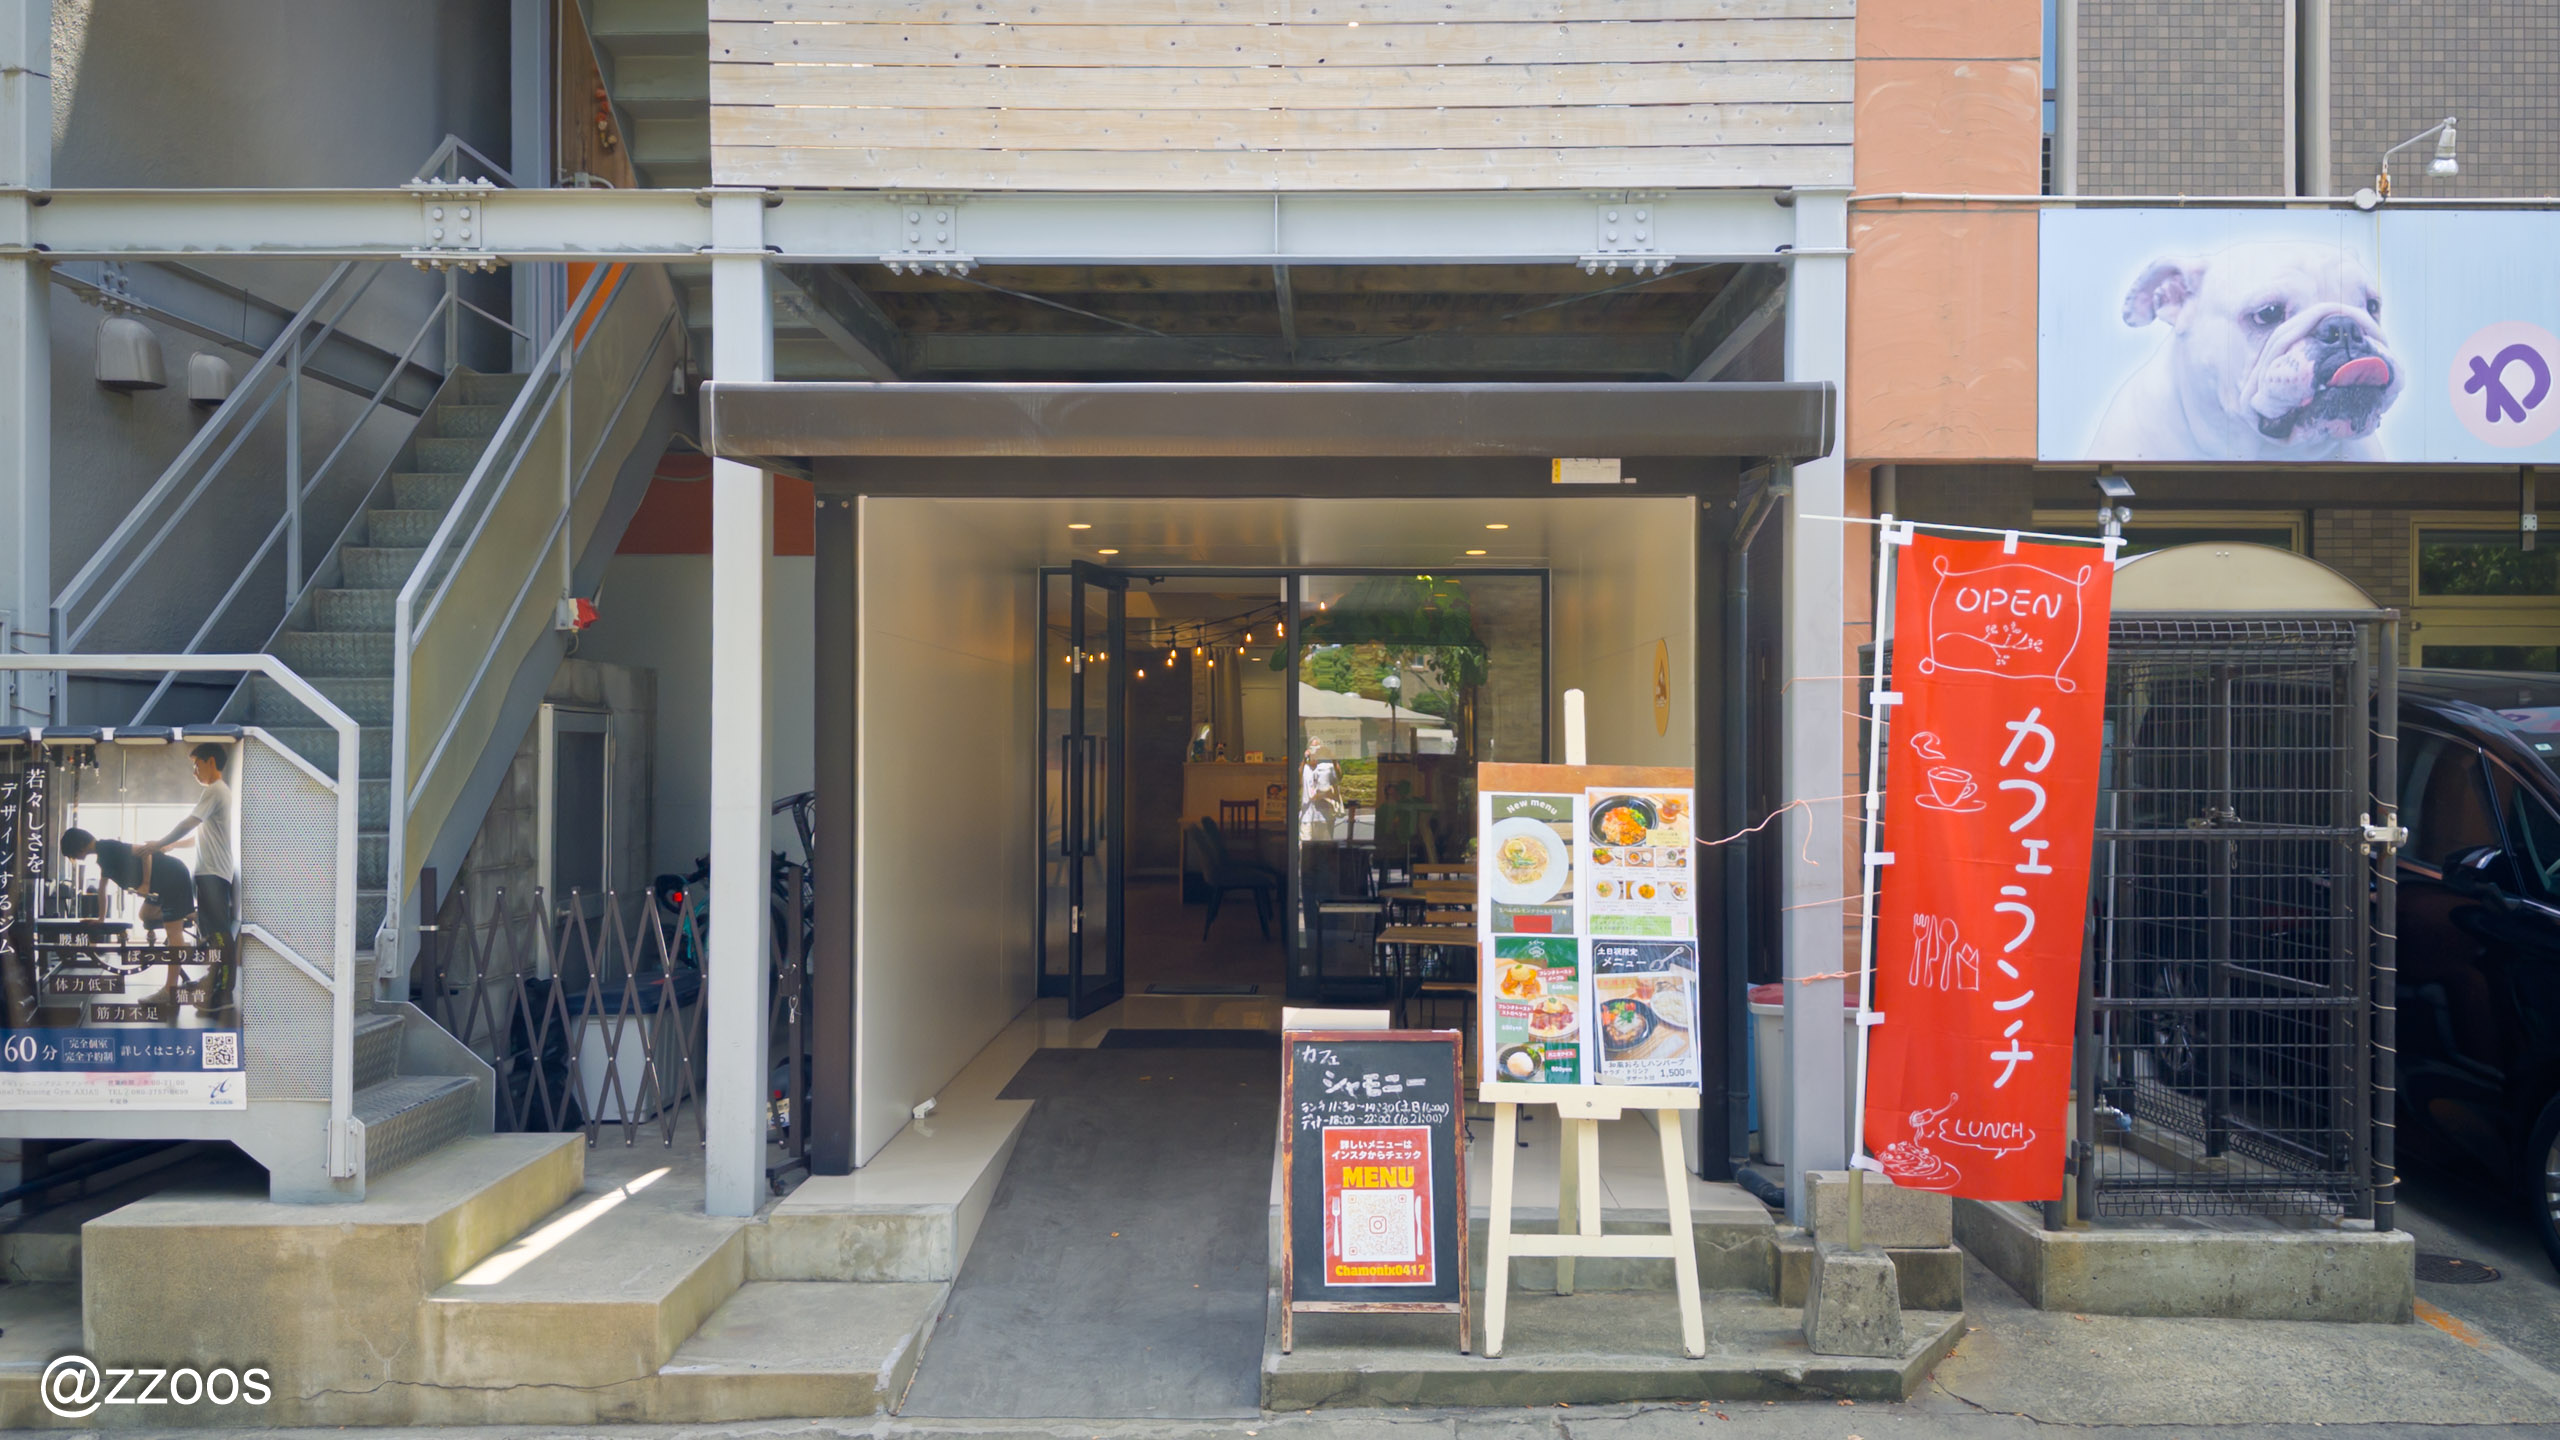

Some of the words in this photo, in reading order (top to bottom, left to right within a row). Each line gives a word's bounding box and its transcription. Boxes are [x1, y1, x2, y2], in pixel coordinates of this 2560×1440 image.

[2464, 344, 2551, 423] わ
[1956, 587, 2062, 618] OPEN
[1506, 800, 1528, 814] New
[1530, 799, 1558, 816] menu
[25, 768, 46, 874] 若々しさを
[0, 782, 18, 954] デザインするジム
[1990, 707, 2056, 1089] カフェランチ
[59, 933, 89, 946] 腰痛
[1597, 947, 1639, 957] 土日祝限定
[1602, 957, 1647, 969] メニュー
[55, 977, 119, 992] 体力低下
[176, 988, 207, 1004] 猫背
[96, 1006, 159, 1021] 筋力不足
[69, 1038, 108, 1049] 完全個室
[120, 1045, 196, 1057] 詳しくはこちら
[64, 1052, 114, 1063] 完全予約制
[1302, 1045, 1340, 1065] カフェ
[1322, 1070, 1426, 1099] シャモニー
[1301, 1100, 1325, 1113] ランチ
[1955, 1119, 2023, 1139] LUNCH
[1340, 1140, 1413, 1150] 詳しいメニューは
[1331, 1151, 1422, 1160] インスタからチェック
[1342, 1166, 1415, 1188] MENU
[1335, 1265, 1426, 1277] Chamonix0417
